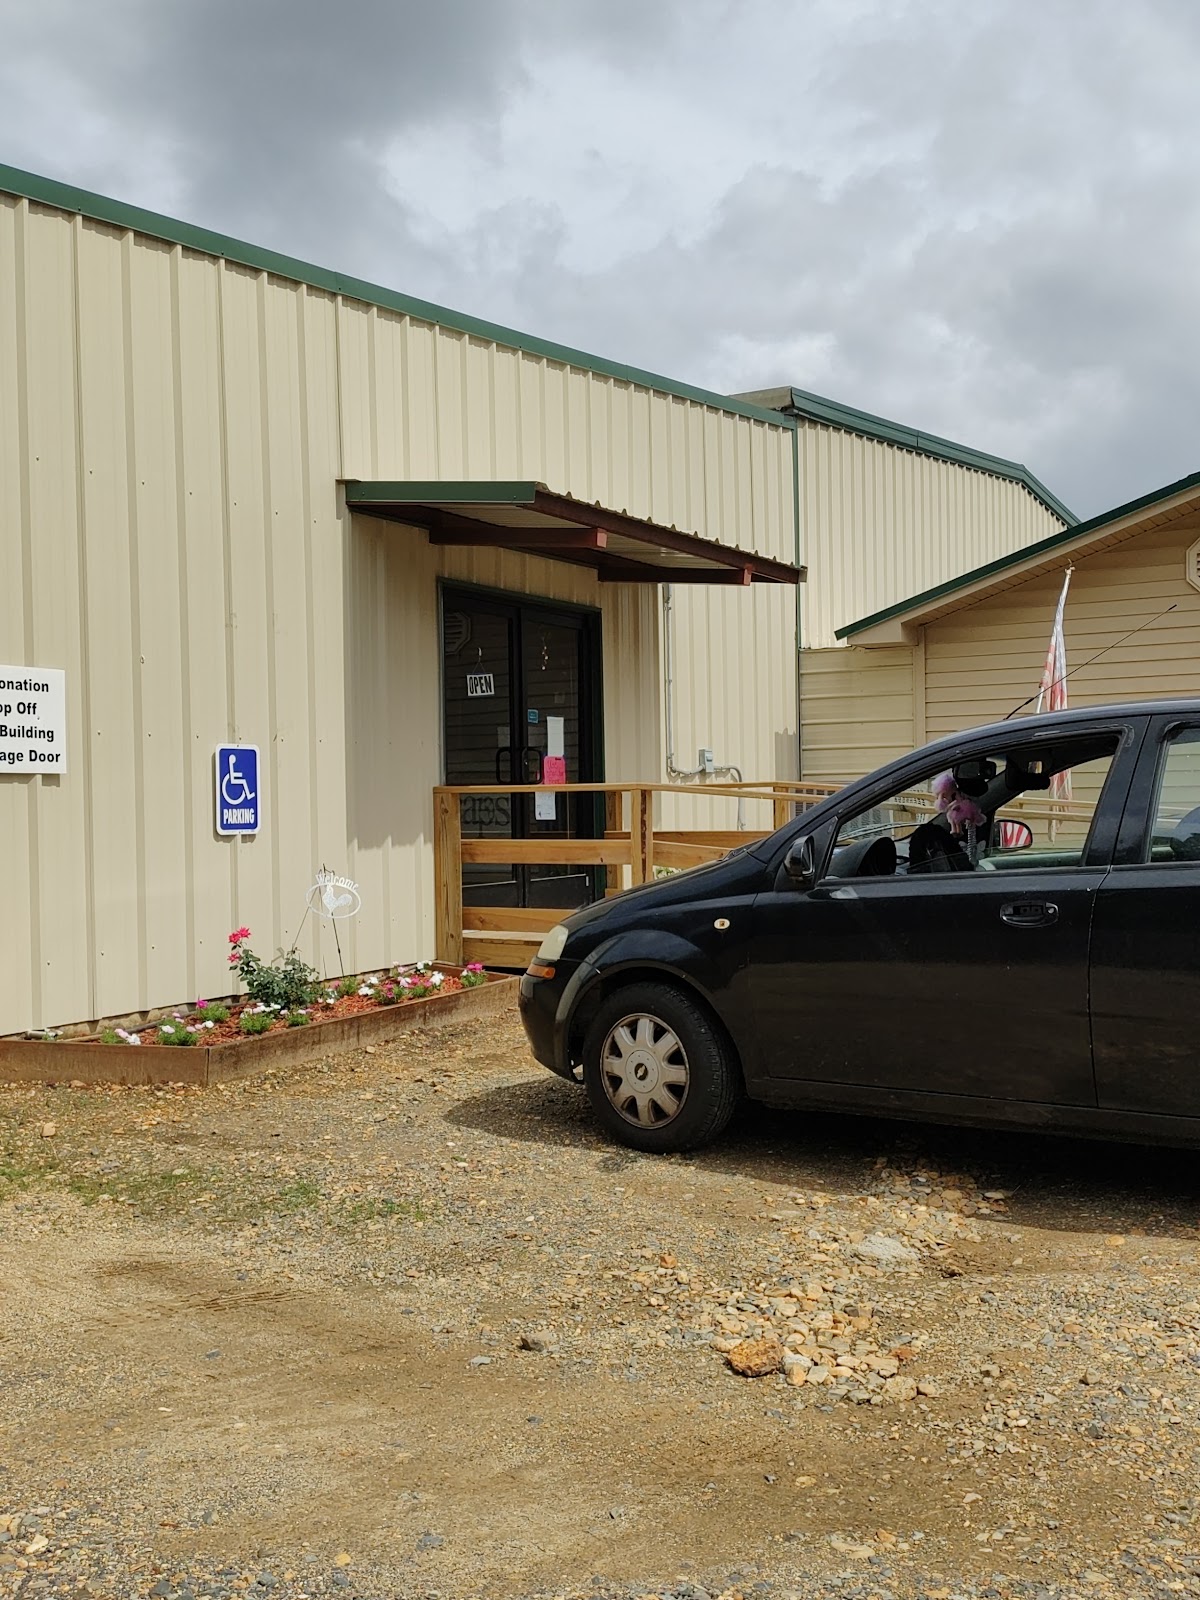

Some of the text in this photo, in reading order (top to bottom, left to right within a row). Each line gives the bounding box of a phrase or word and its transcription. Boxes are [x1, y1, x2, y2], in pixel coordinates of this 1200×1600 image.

[469, 675, 492, 694] OPEN
[17, 702, 37, 715] Off
[0, 725, 55, 742] Building
[29, 750, 61, 762] Door
[223, 808, 255, 825] PARKING
[315, 872, 359, 891] Welcome
